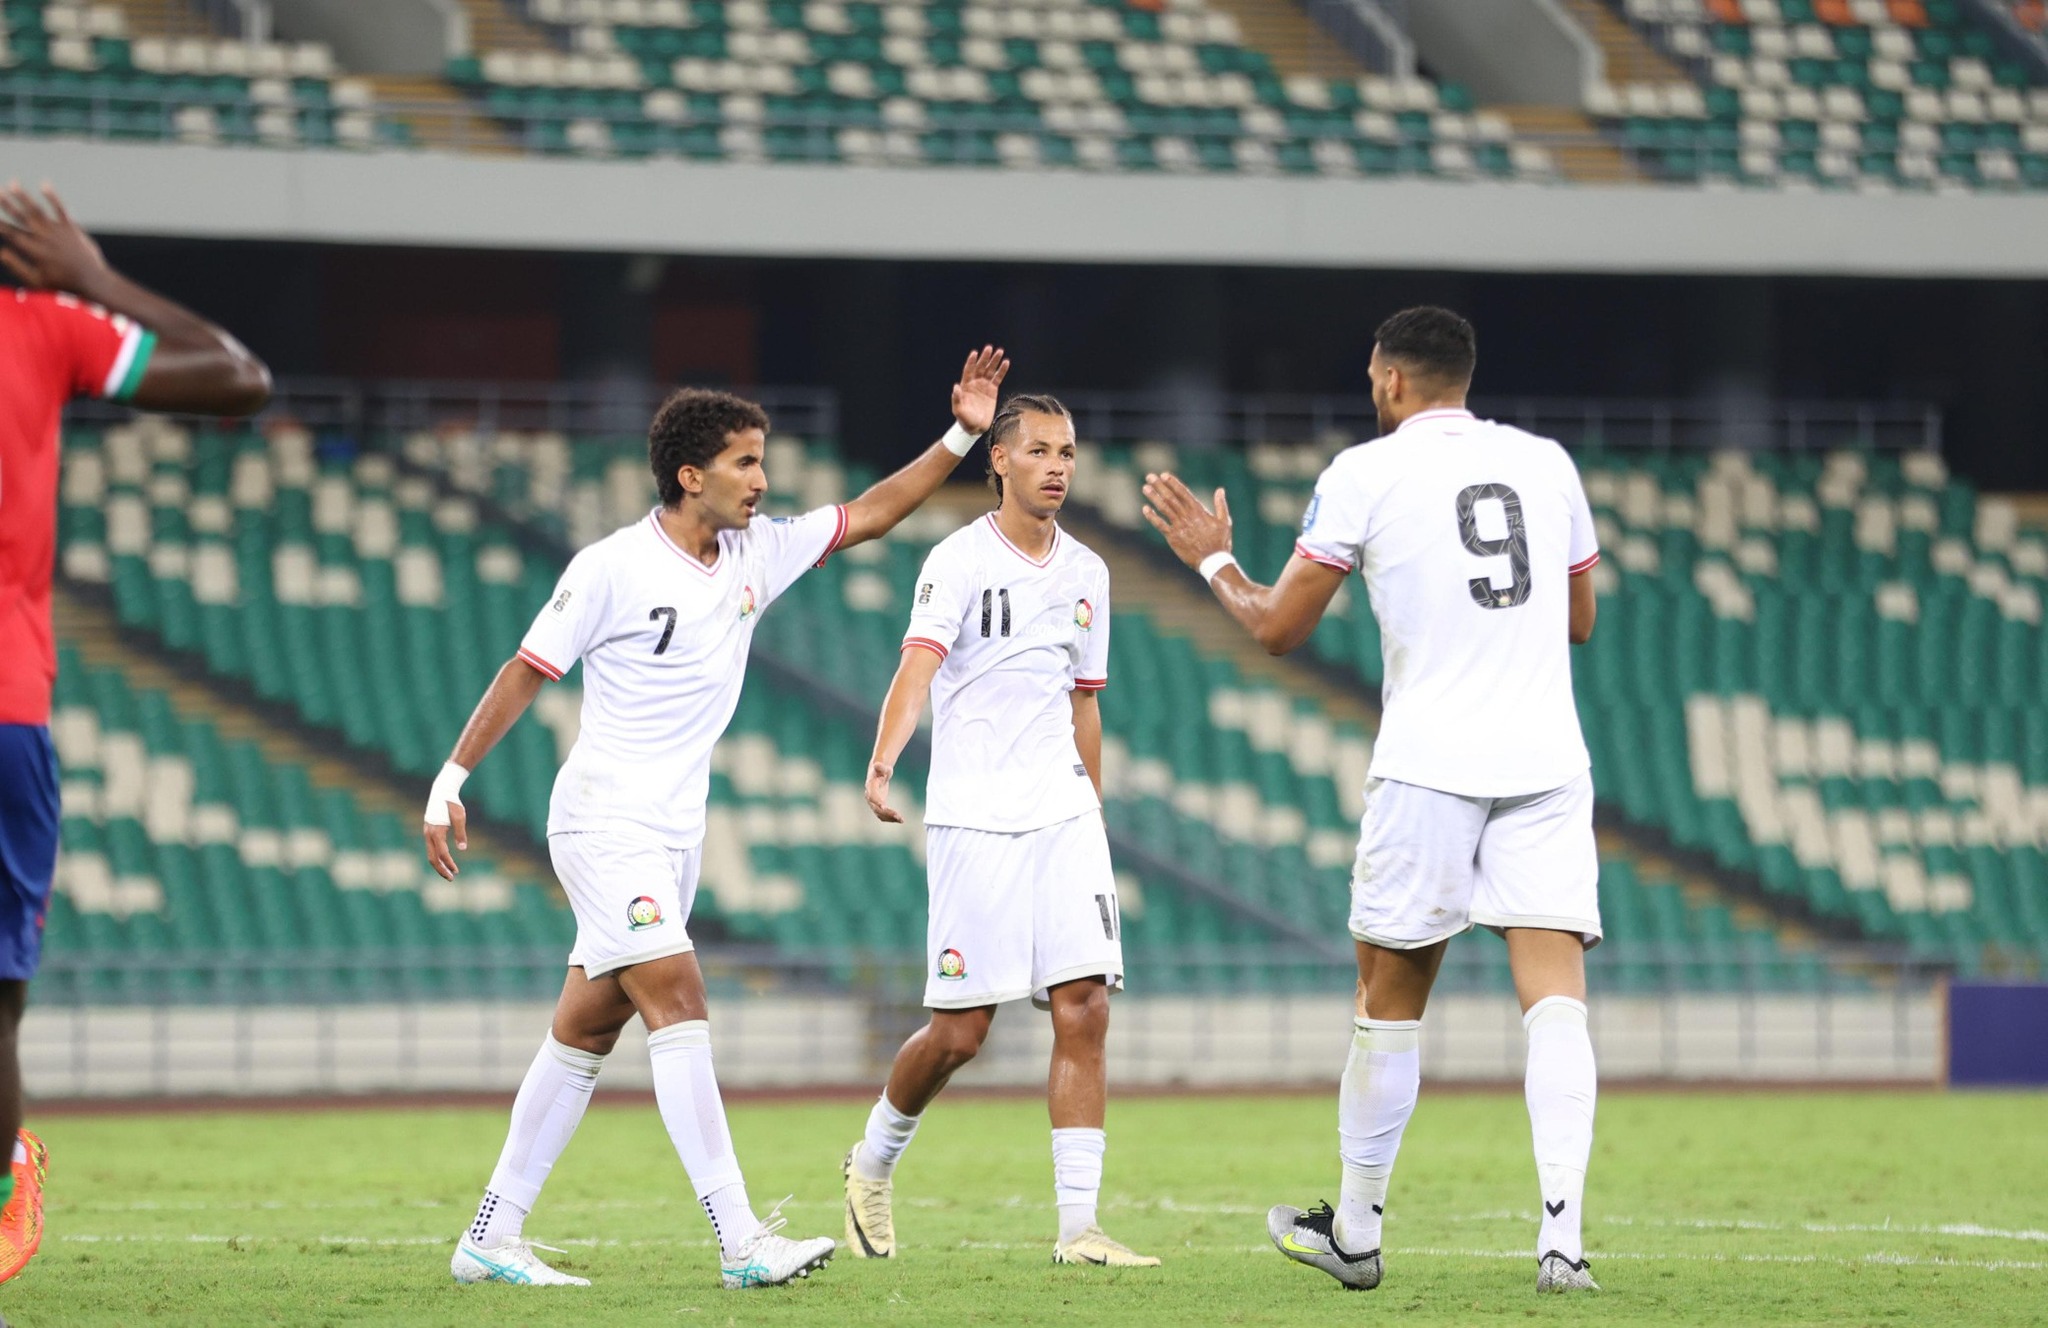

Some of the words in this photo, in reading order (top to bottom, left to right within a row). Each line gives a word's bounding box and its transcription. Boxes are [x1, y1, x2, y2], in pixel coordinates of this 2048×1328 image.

[1455, 482, 1532, 610] 9
[649, 606, 678, 656] 7
[981, 588, 1011, 638] 11
